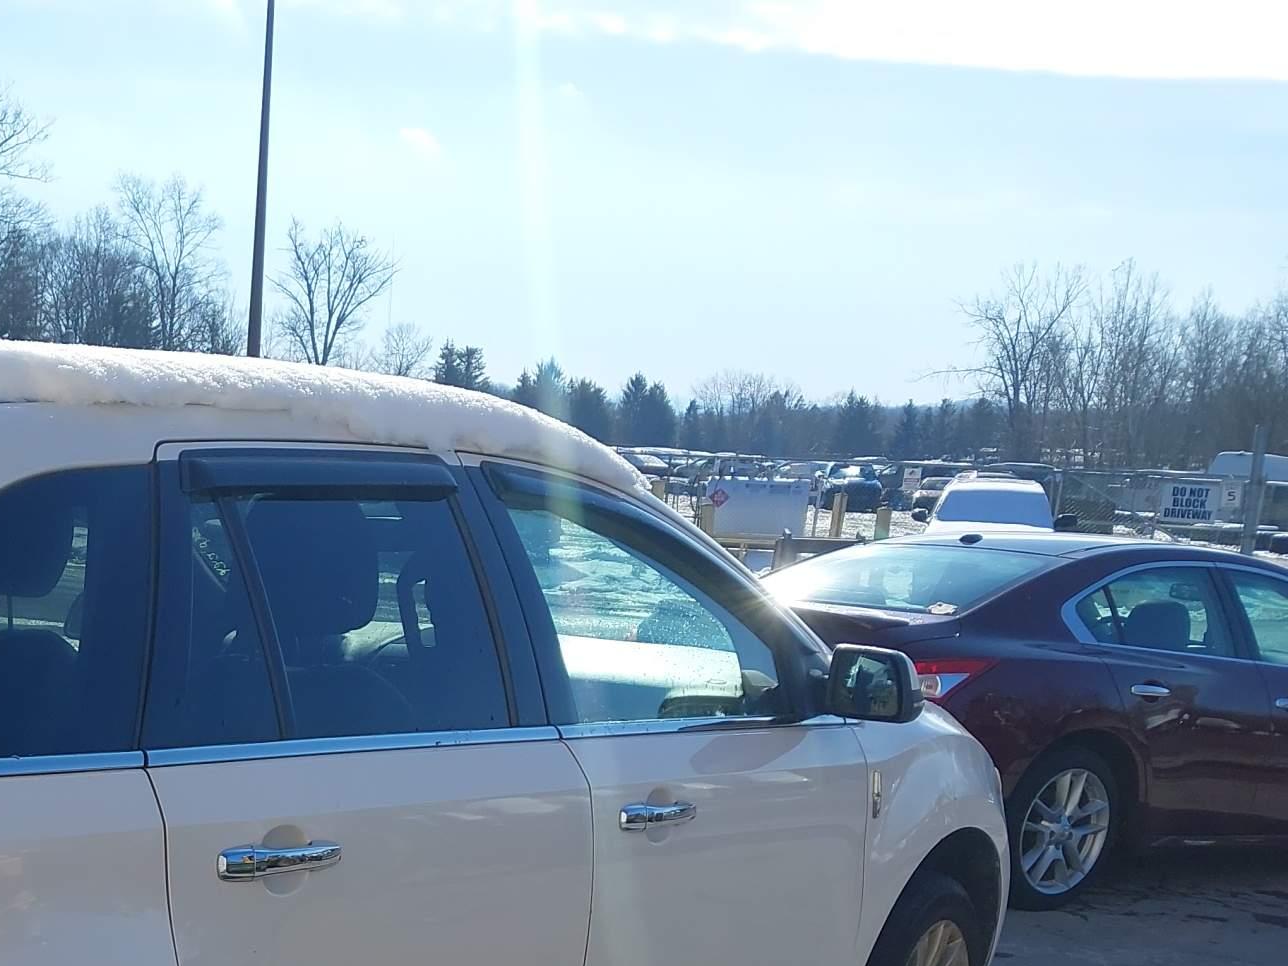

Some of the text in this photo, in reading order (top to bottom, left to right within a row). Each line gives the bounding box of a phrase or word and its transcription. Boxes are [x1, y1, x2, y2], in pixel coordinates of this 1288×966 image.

[1172, 486, 1210, 498] DO NOT
[1172, 497, 1208, 509] BLOCK
[1163, 507, 1213, 520] DRIVEWAY
